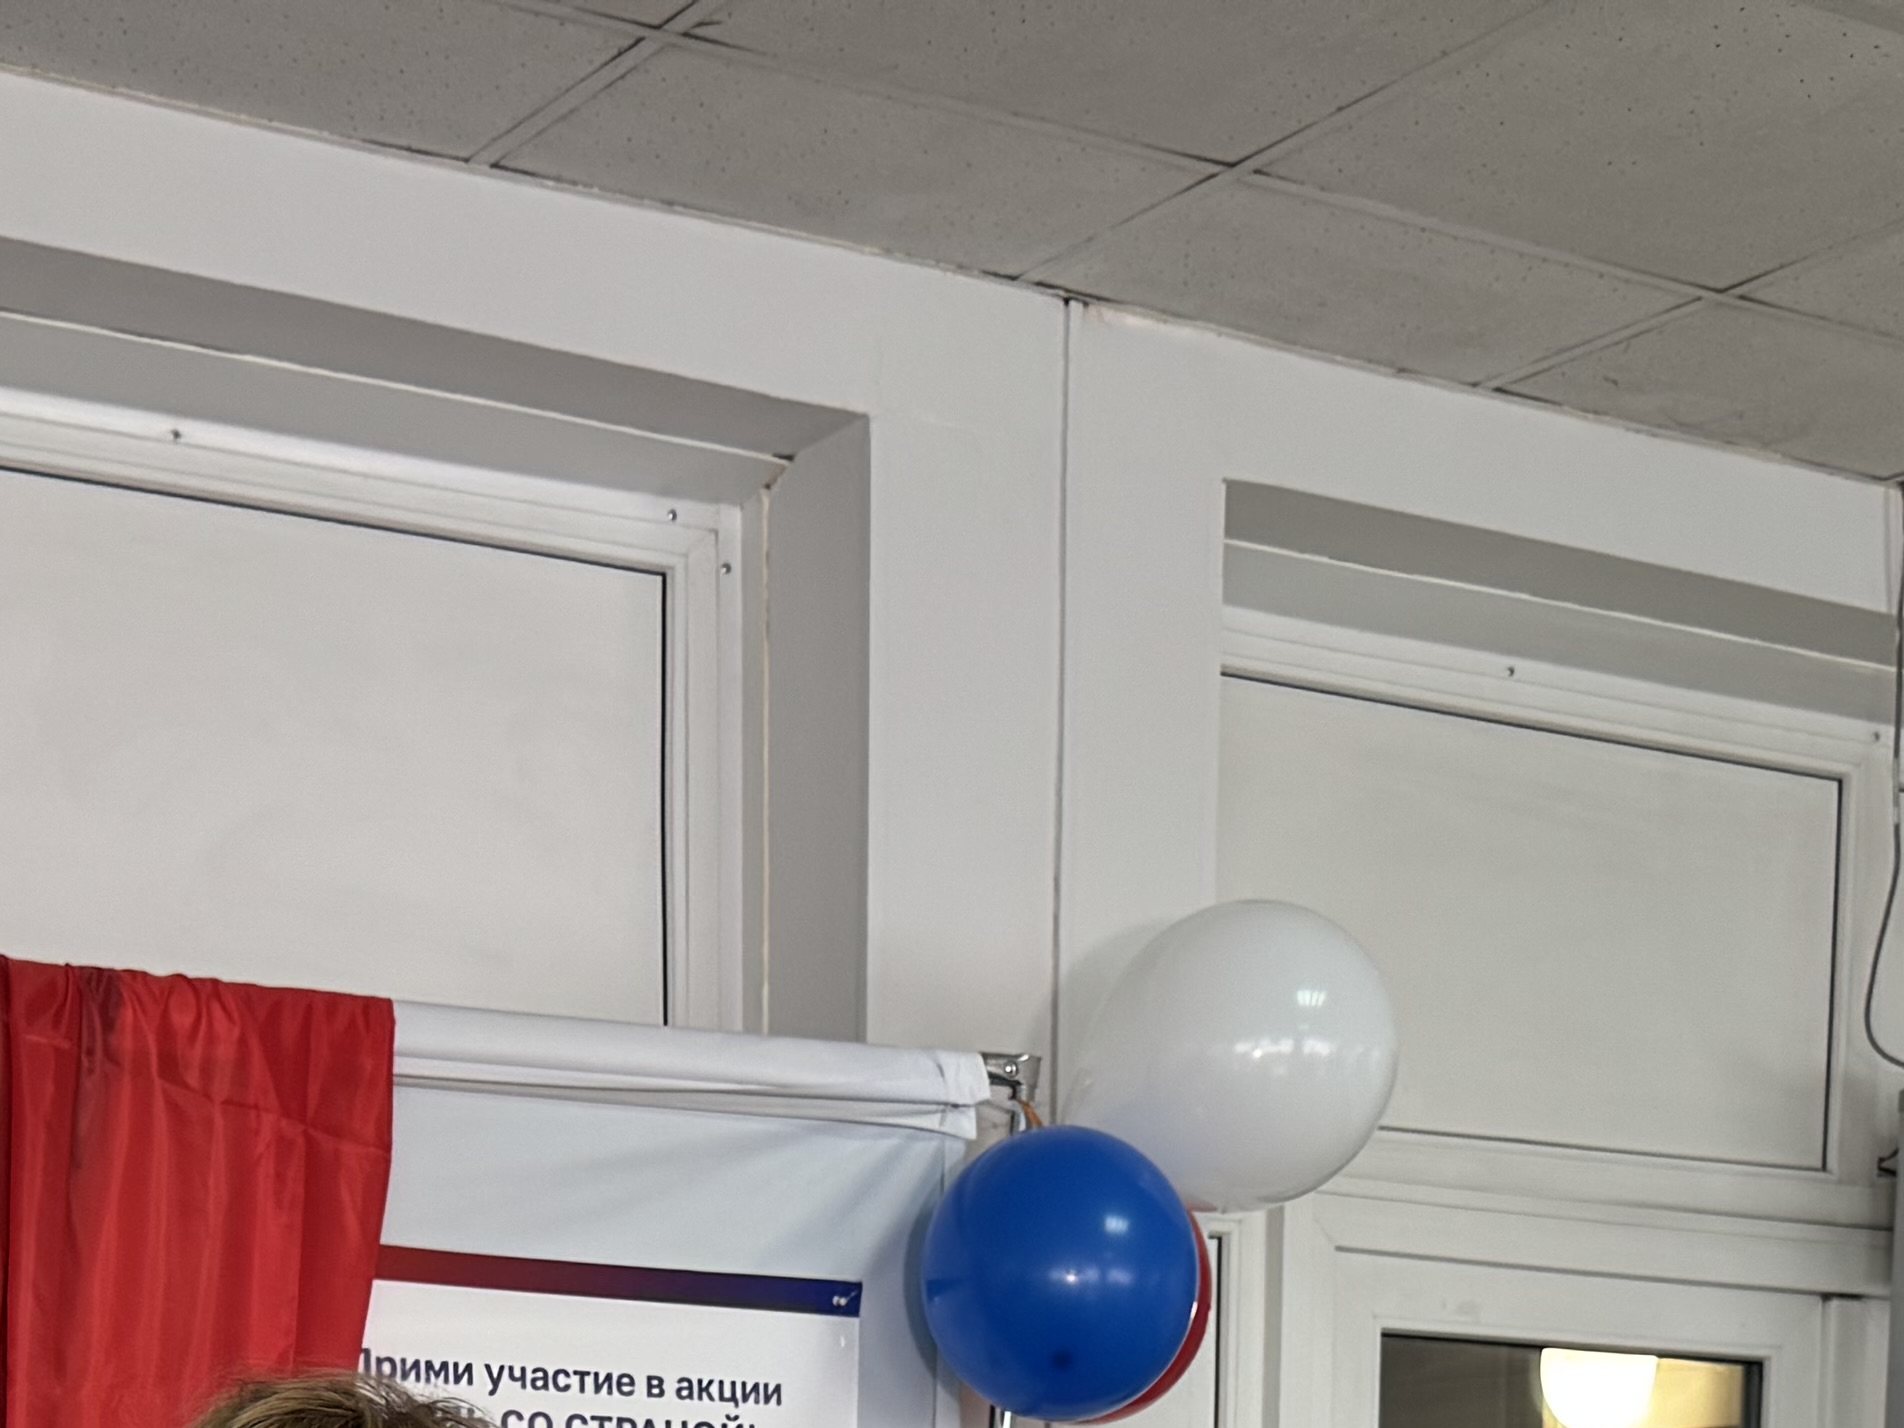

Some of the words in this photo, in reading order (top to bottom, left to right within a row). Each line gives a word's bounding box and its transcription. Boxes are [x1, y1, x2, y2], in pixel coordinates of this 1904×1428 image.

[484, 1363, 636, 1397] участие
[646, 1375, 665, 1398] в
[675, 1377, 782, 1408] акции
